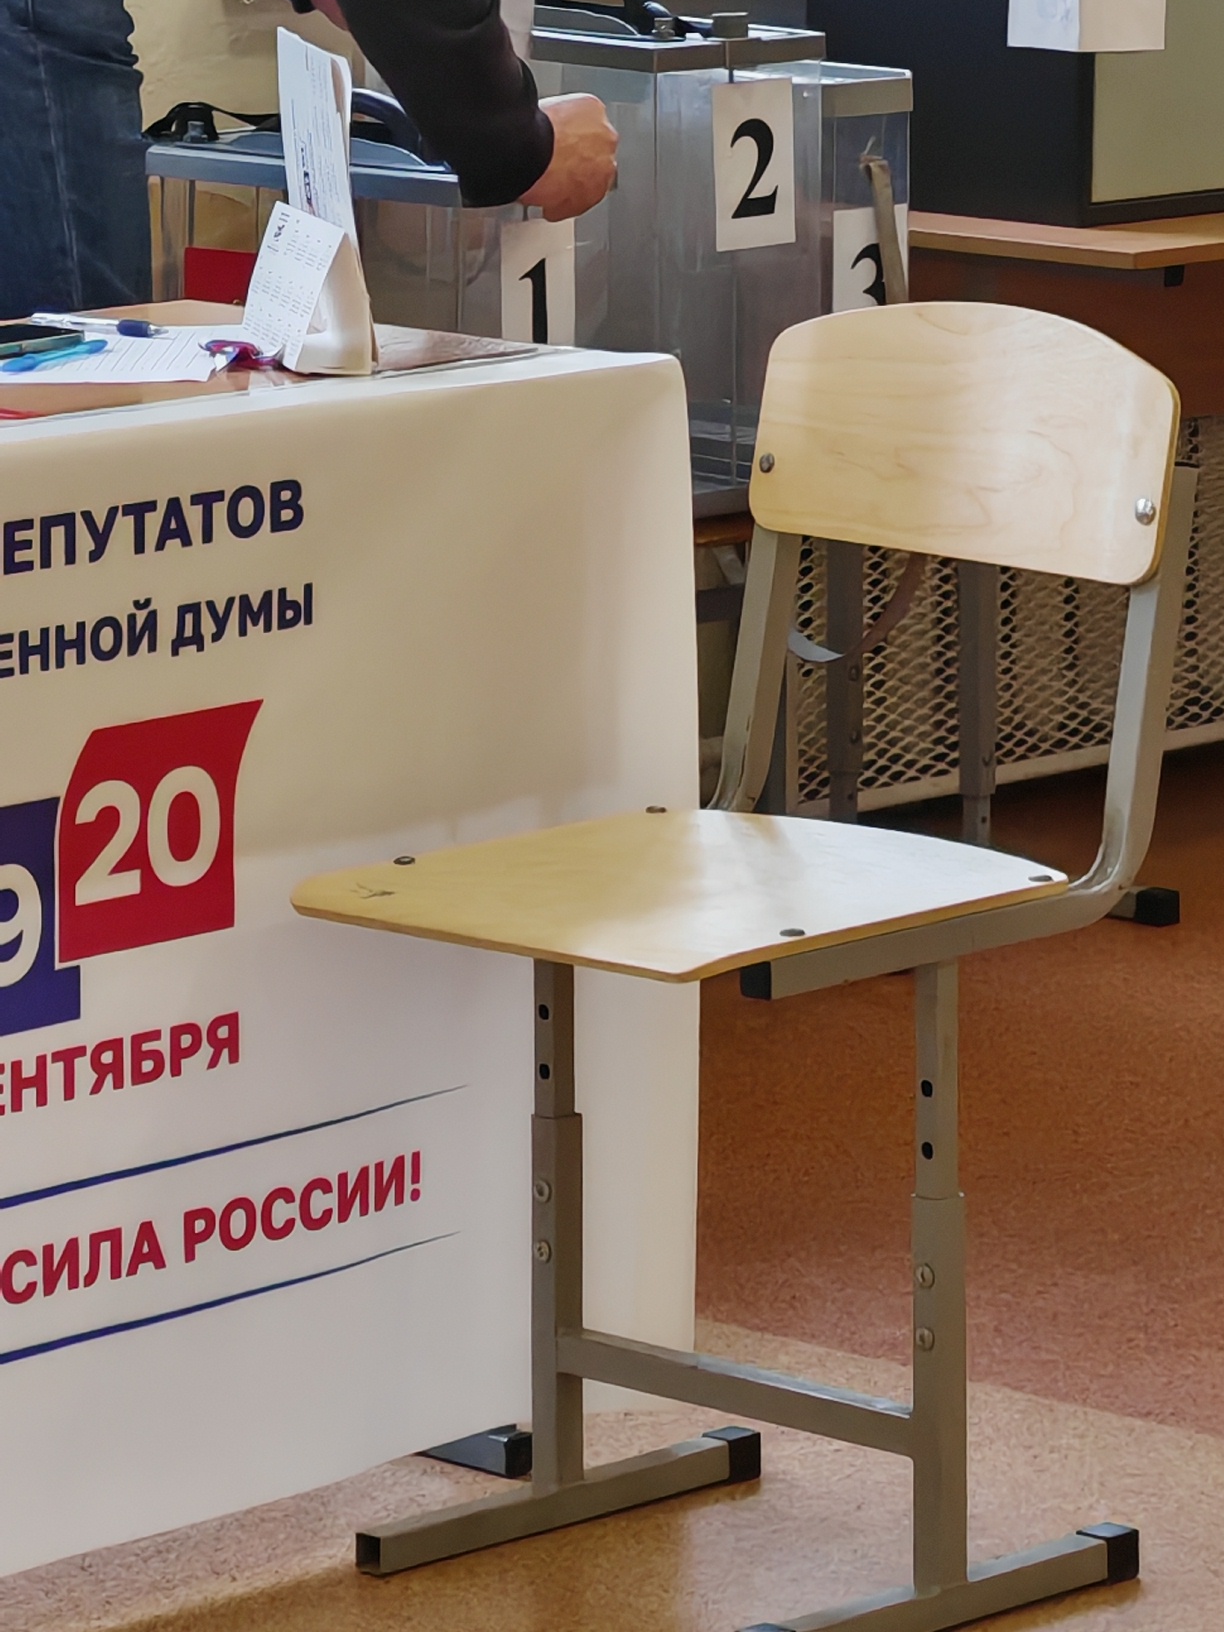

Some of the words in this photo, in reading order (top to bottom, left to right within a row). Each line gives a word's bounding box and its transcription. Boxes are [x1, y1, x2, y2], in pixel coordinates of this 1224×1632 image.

[730, 118, 779, 219] 2
[519, 258, 548, 344] 1
[171, 582, 313, 657] ДУМЫ
[75, 766, 220, 906] 20
[0, 1011, 239, 1116] НТЯБРЯ
[1, 1220, 166, 1305] СИЛА
[183, 1151, 421, 1264] РОССИИ!
